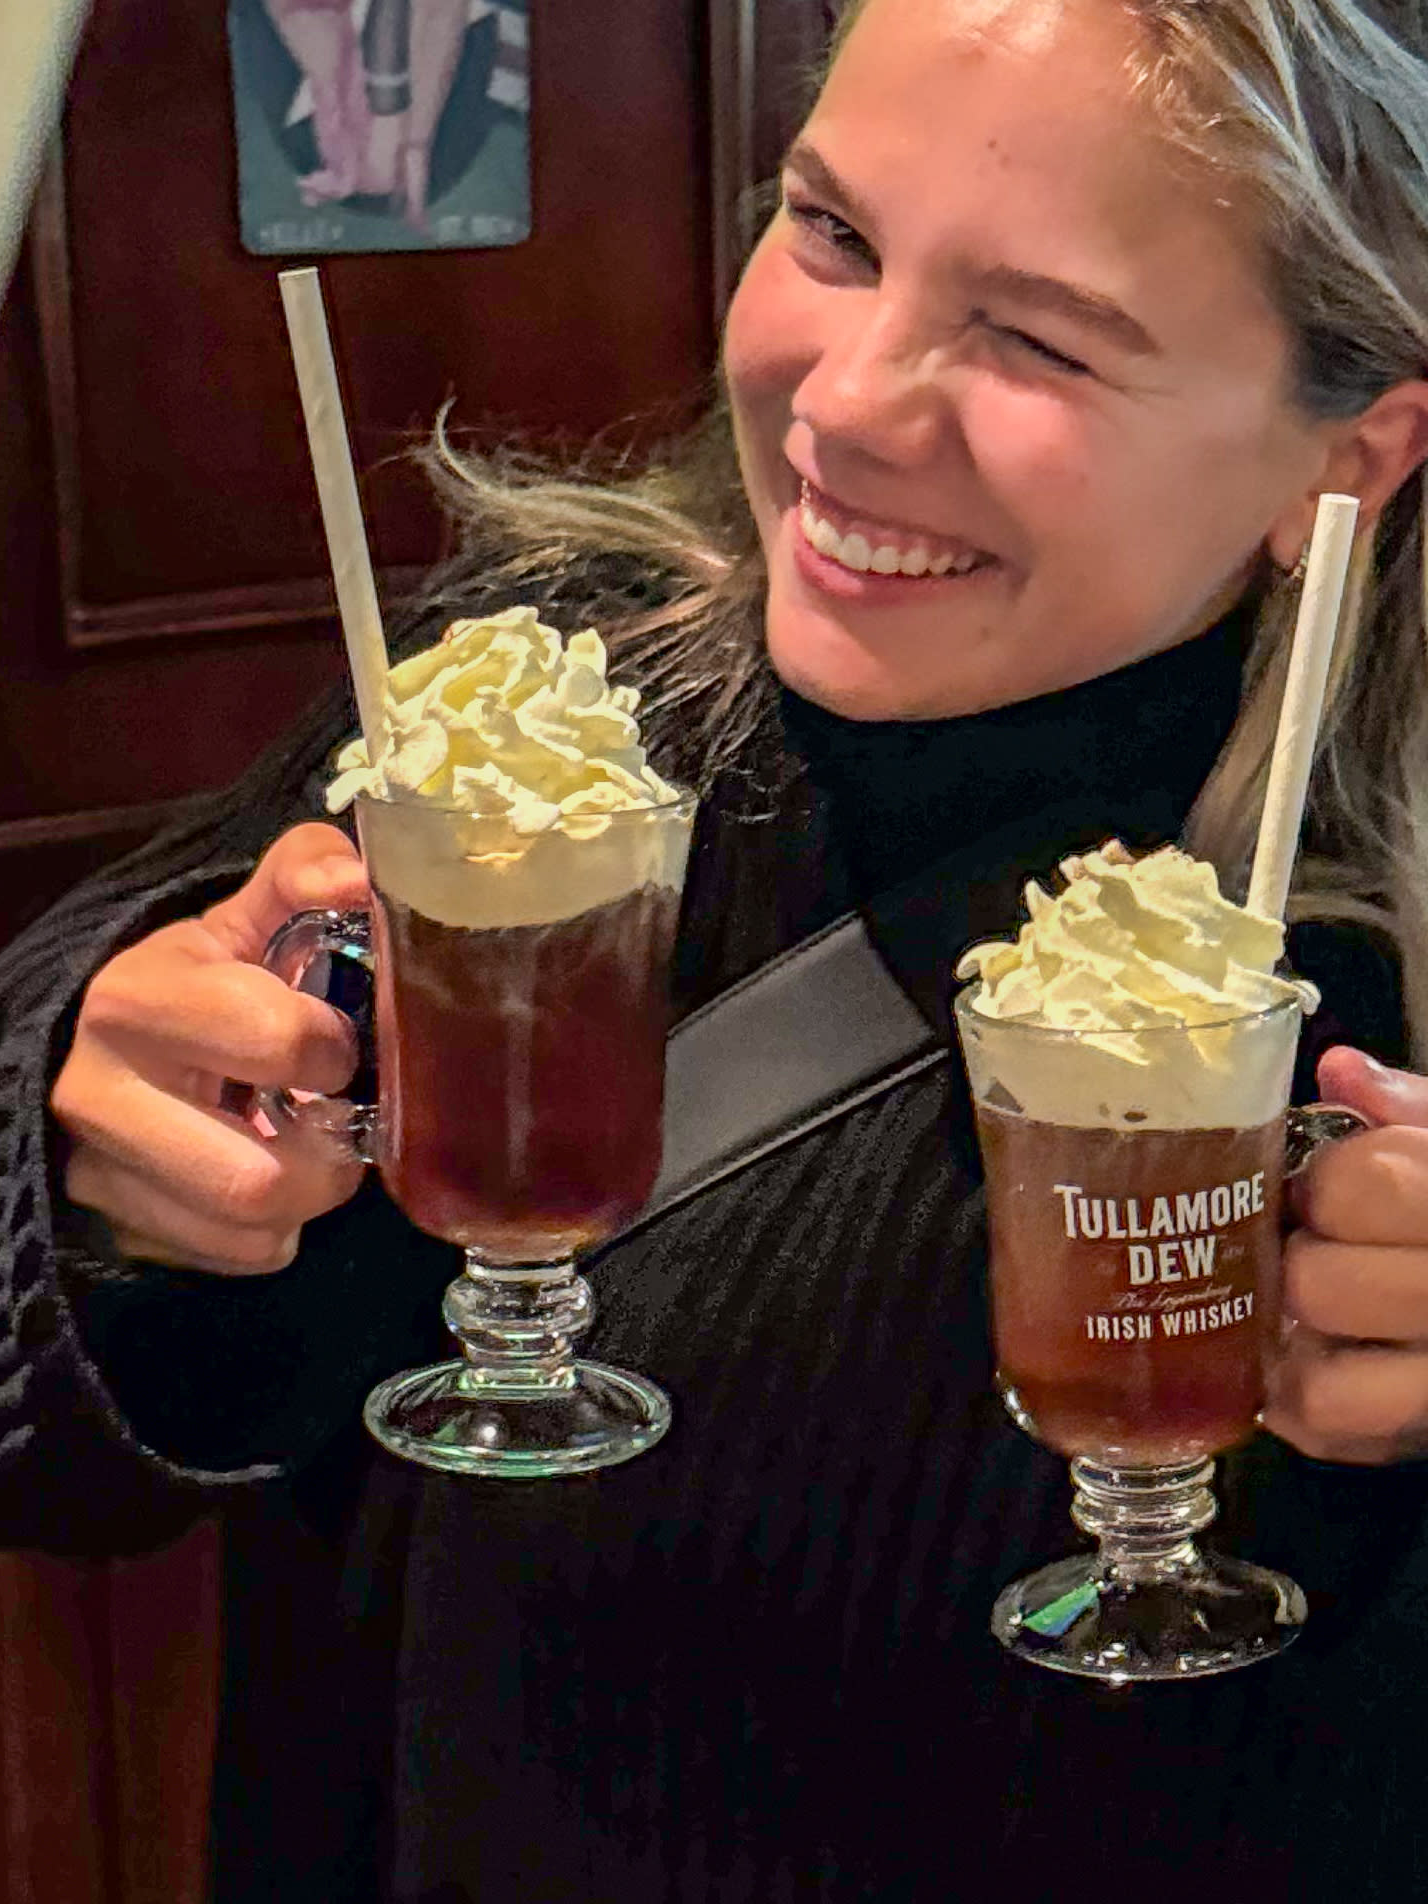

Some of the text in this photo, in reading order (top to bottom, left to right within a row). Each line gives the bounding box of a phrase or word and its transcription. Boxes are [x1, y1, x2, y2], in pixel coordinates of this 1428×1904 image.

[1053, 1171, 1265, 1239] TULLAMORE
[1087, 1292, 1253, 1340] IRISH WHISKEY
